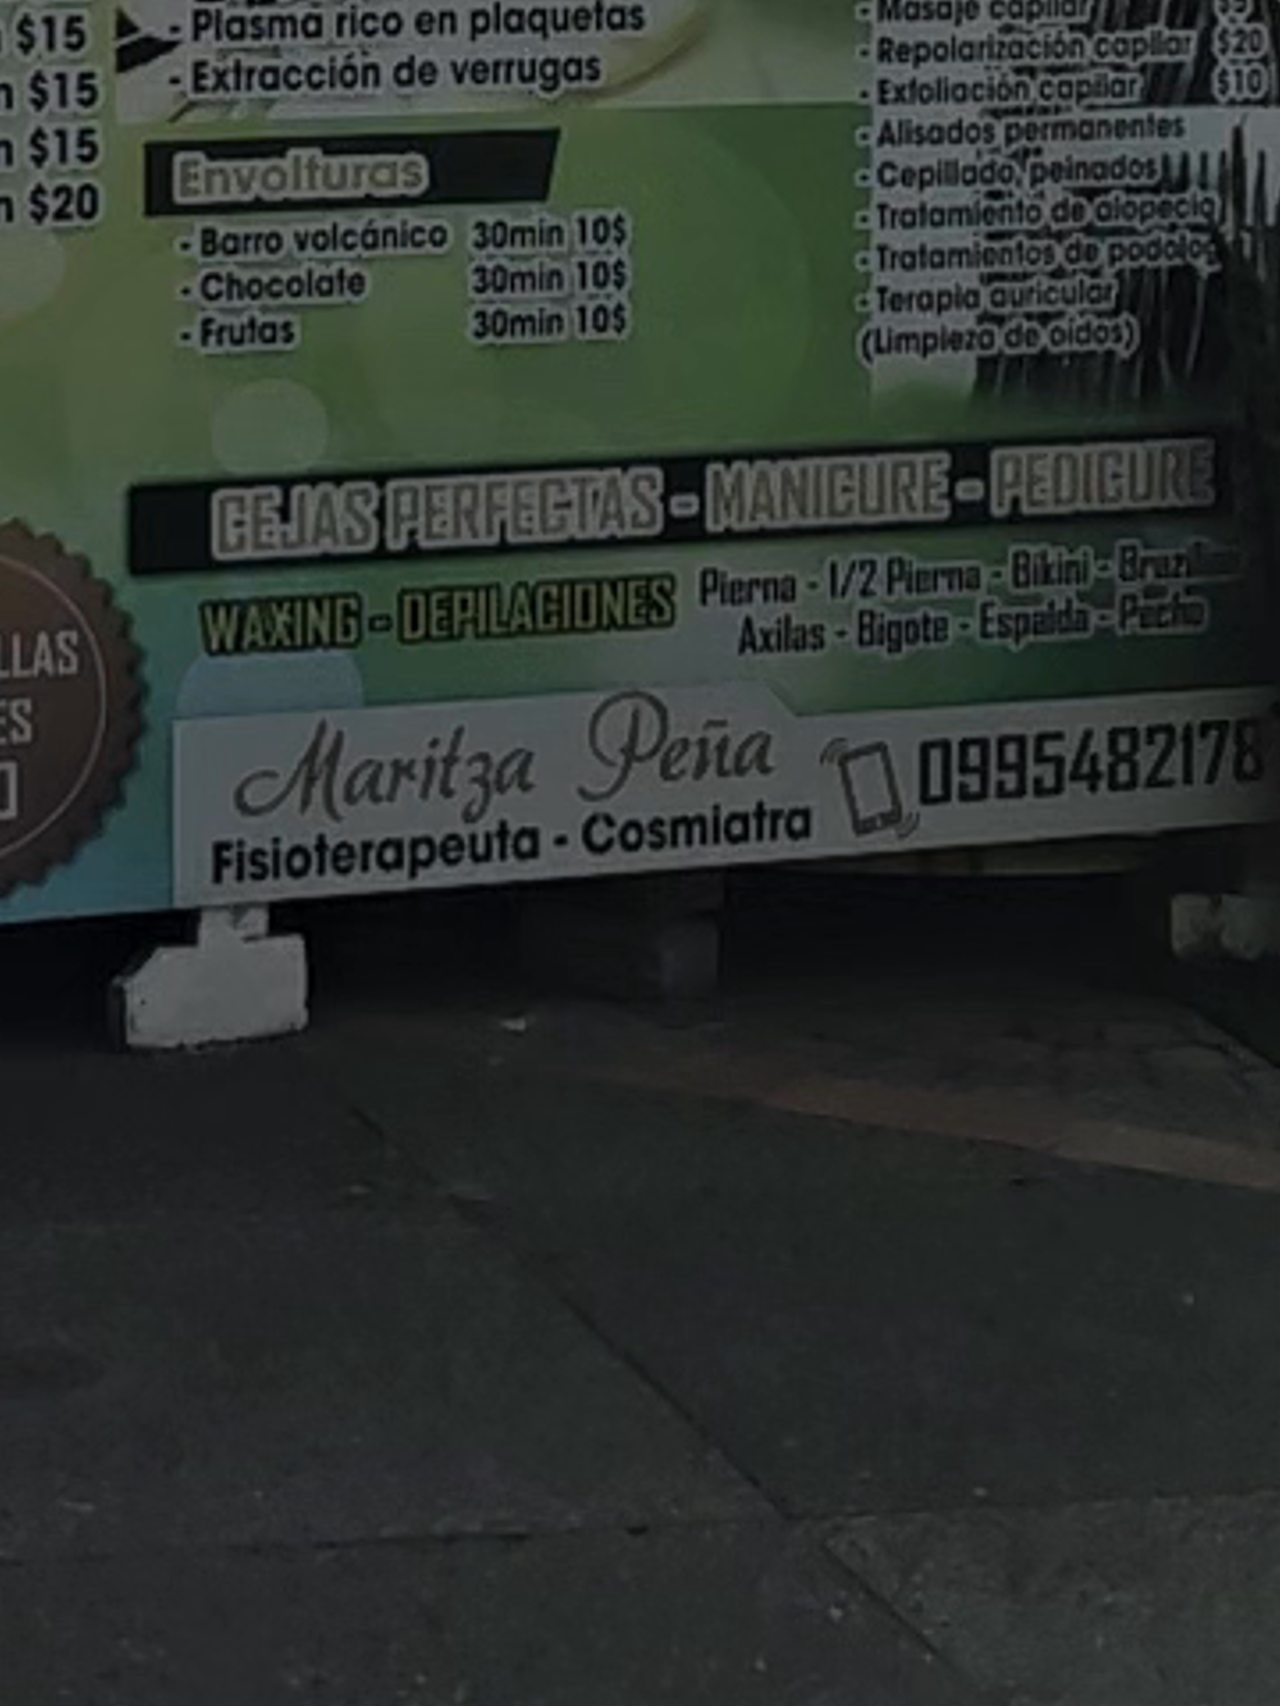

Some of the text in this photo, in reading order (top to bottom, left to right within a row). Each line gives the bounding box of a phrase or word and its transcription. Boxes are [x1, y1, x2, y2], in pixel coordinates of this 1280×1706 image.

[17, 14, 85, 55] $15
[193, 45, 603, 98] Extracción de verrugas
[878, 114, 1184, 146] Alisados permanentes
[177, 152, 425, 199] Envolturas
[30, 184, 98, 224] $20
[201, 214, 626, 257] Barro volcánico 30min 10$
[201, 259, 626, 306] Chocolate 30min 10$
[215, 441, 1215, 557] CEJAS PERFECTAS MANICURE PEDICURE
[700, 552, 1090, 606] Pierna 1/2 Pierna Bikini
[203, 576, 674, 654] WAXING DEPILACIONES
[739, 592, 1204, 655] Axilas Bigote Espalda Pecho
[235, 691, 774, 823] Maritza Peña
[213, 801, 811, 884] Fisioterapeuta Cosmiatra
